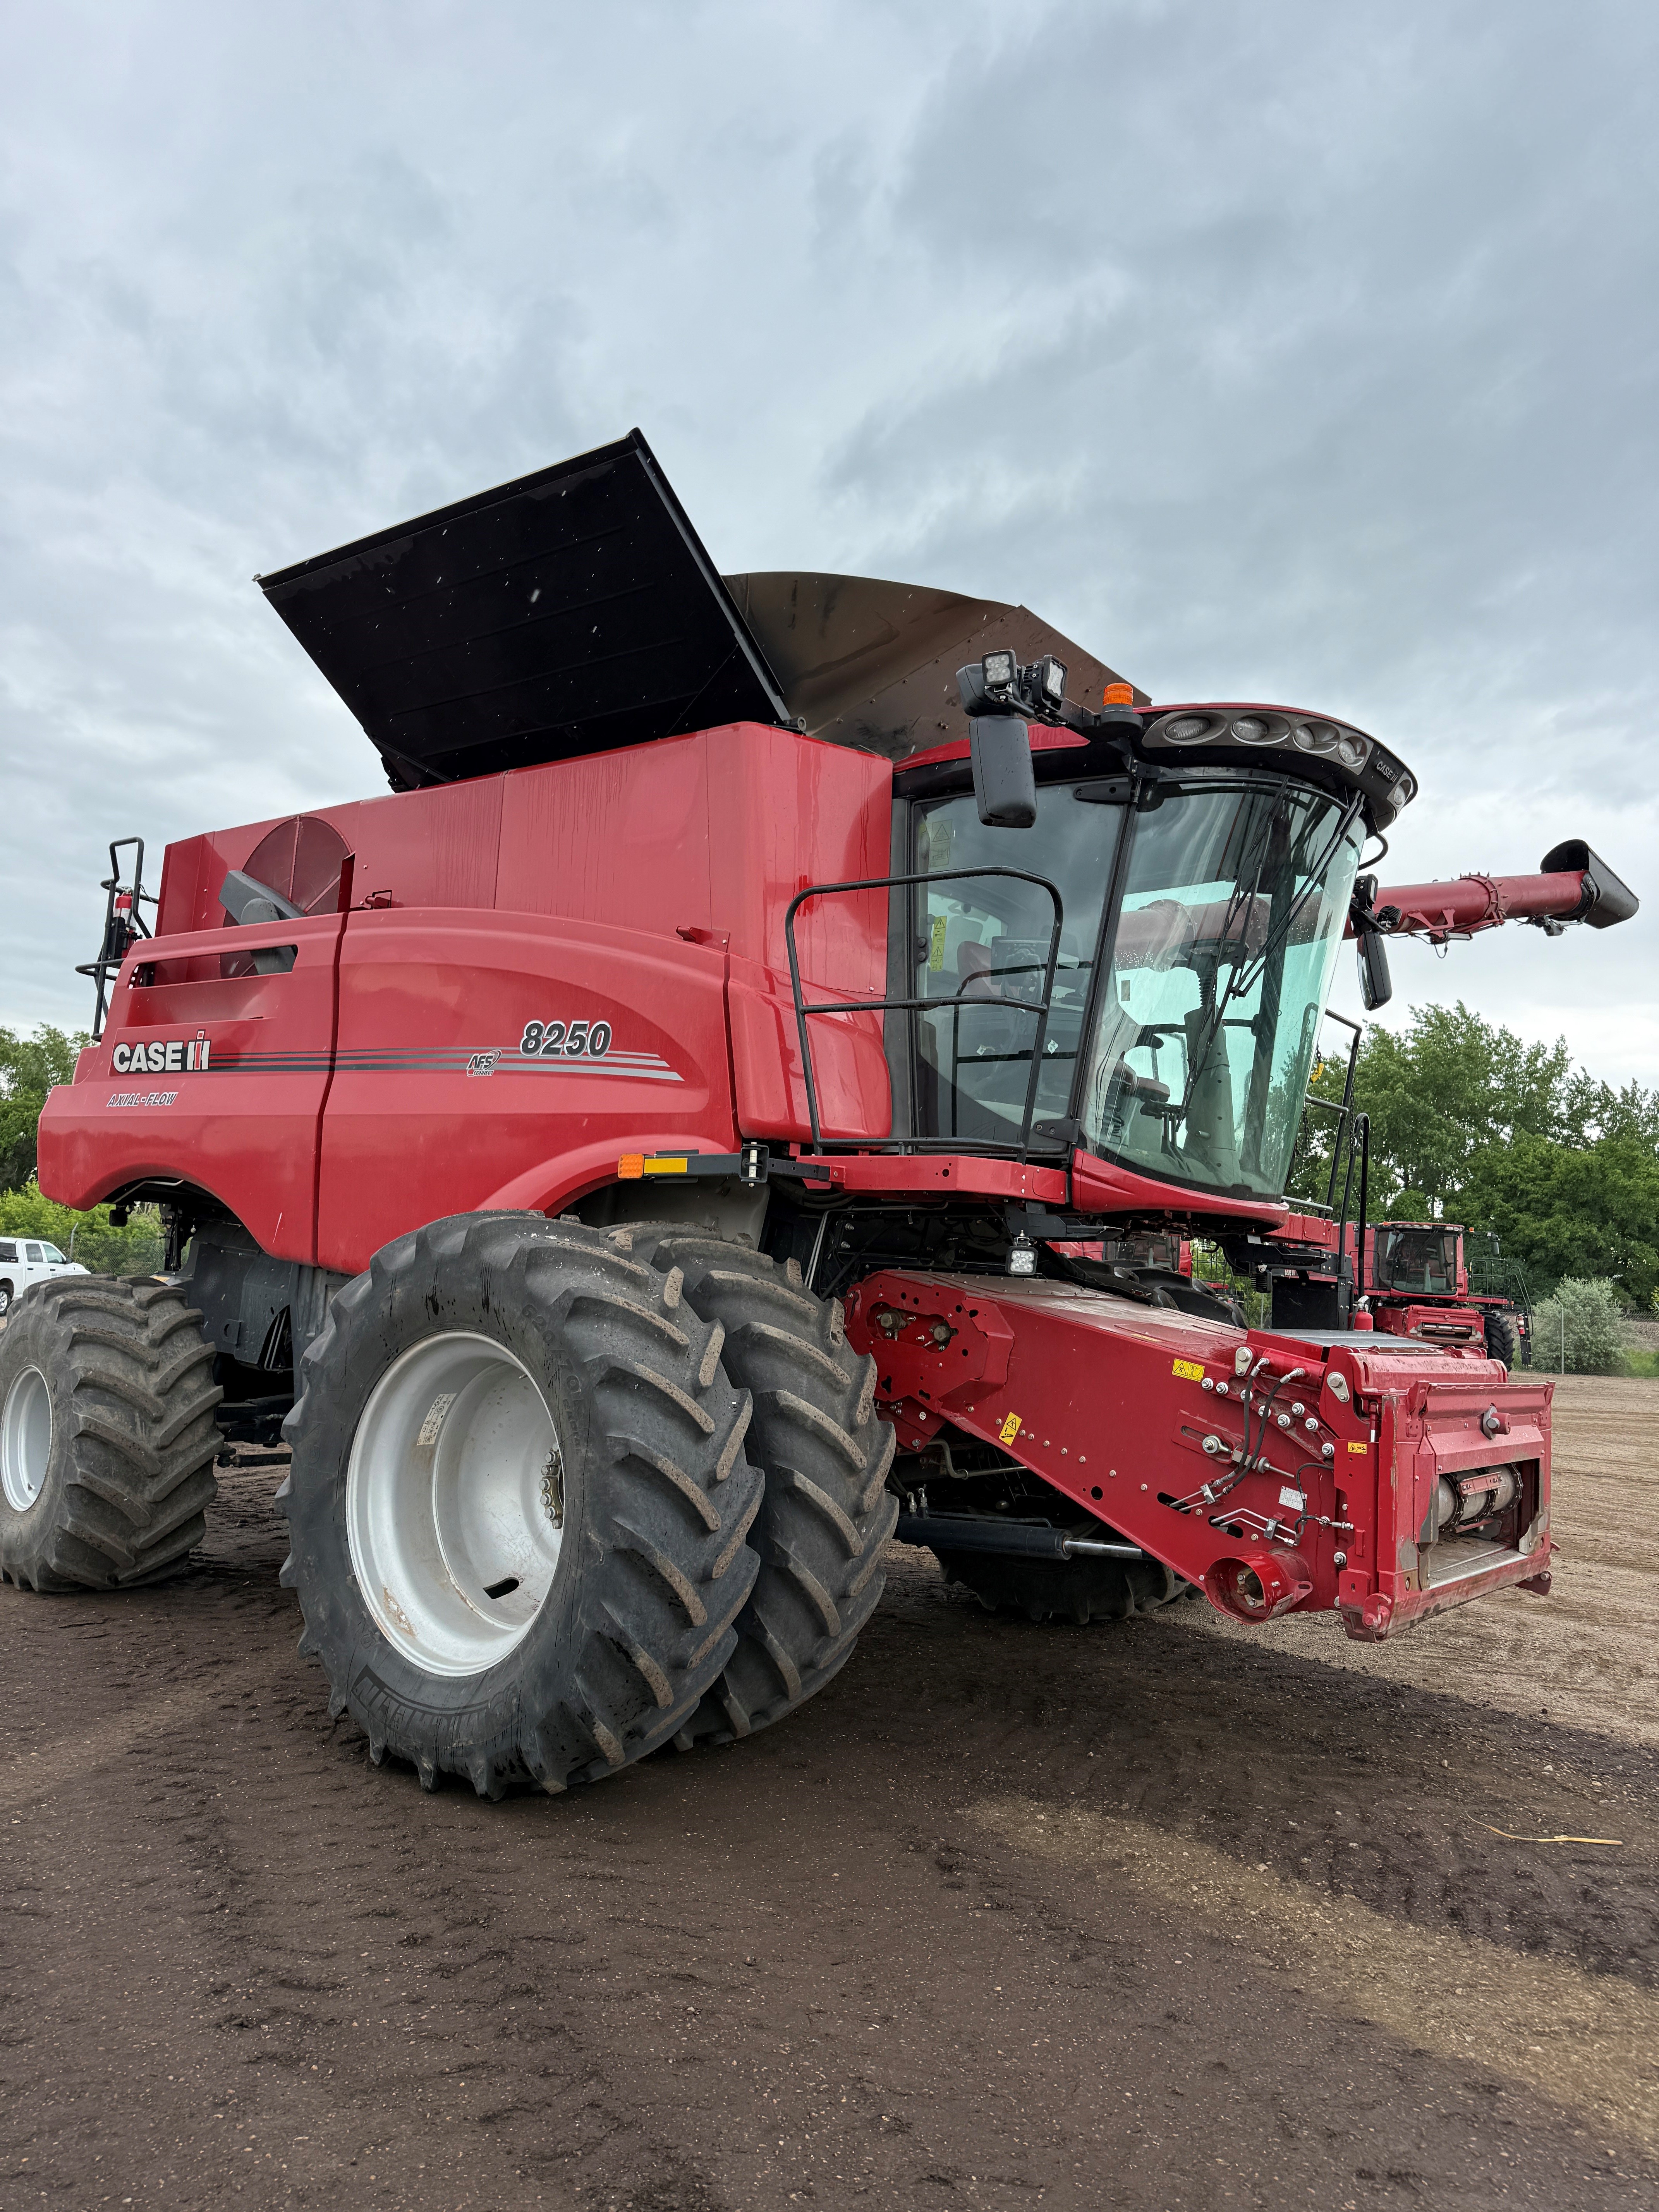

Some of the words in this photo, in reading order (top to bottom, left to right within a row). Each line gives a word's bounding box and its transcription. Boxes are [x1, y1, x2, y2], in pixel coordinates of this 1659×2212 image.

[1376, 761, 1393, 779] CASE
[520, 1020, 612, 1058] 8250
[113, 1041, 184, 1073] CASE
[466, 1053, 495, 1070] AFS
[106, 1092, 179, 1107] AXIAL-FLOW
